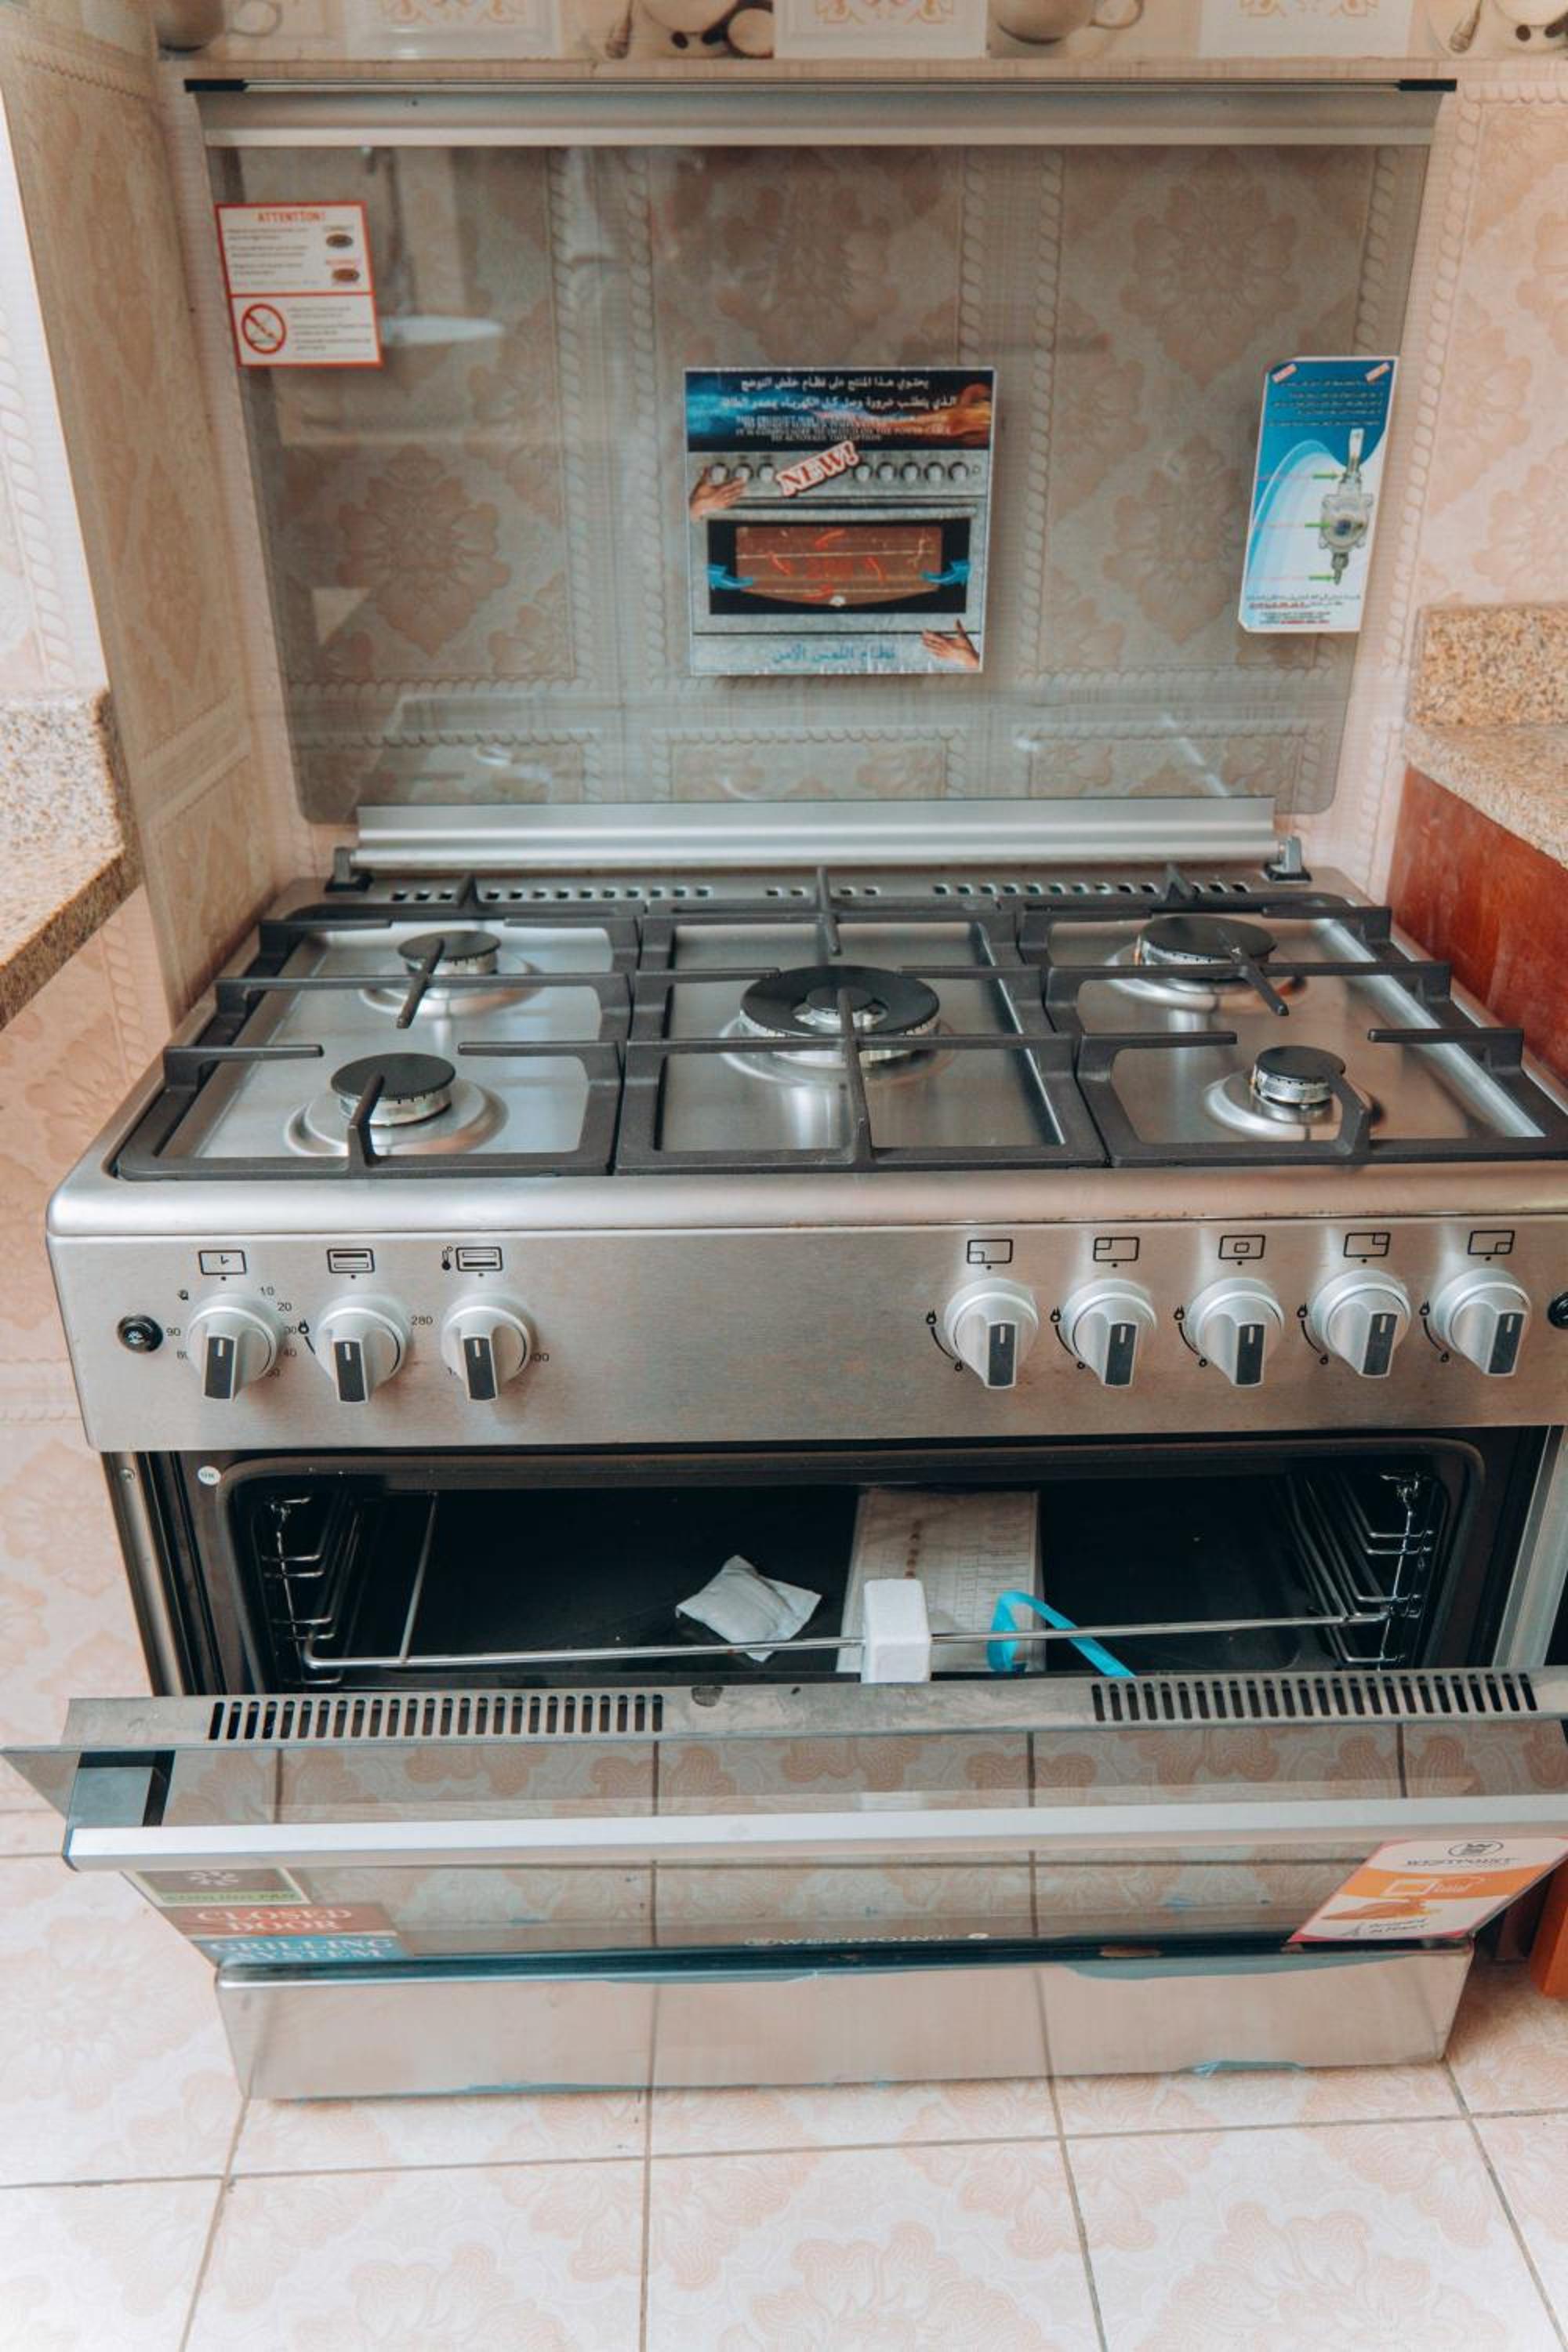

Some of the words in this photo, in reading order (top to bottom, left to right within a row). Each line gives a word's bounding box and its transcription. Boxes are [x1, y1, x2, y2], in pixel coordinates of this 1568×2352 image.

[777, 441, 859, 495] NEW!
[260, 1286, 274, 1296] 10
[277, 1301, 292, 1312] 20
[411, 1316, 434, 1326] 280
[165, 1327, 181, 1337] 90
[197, 1907, 353, 1922] CLOSED
